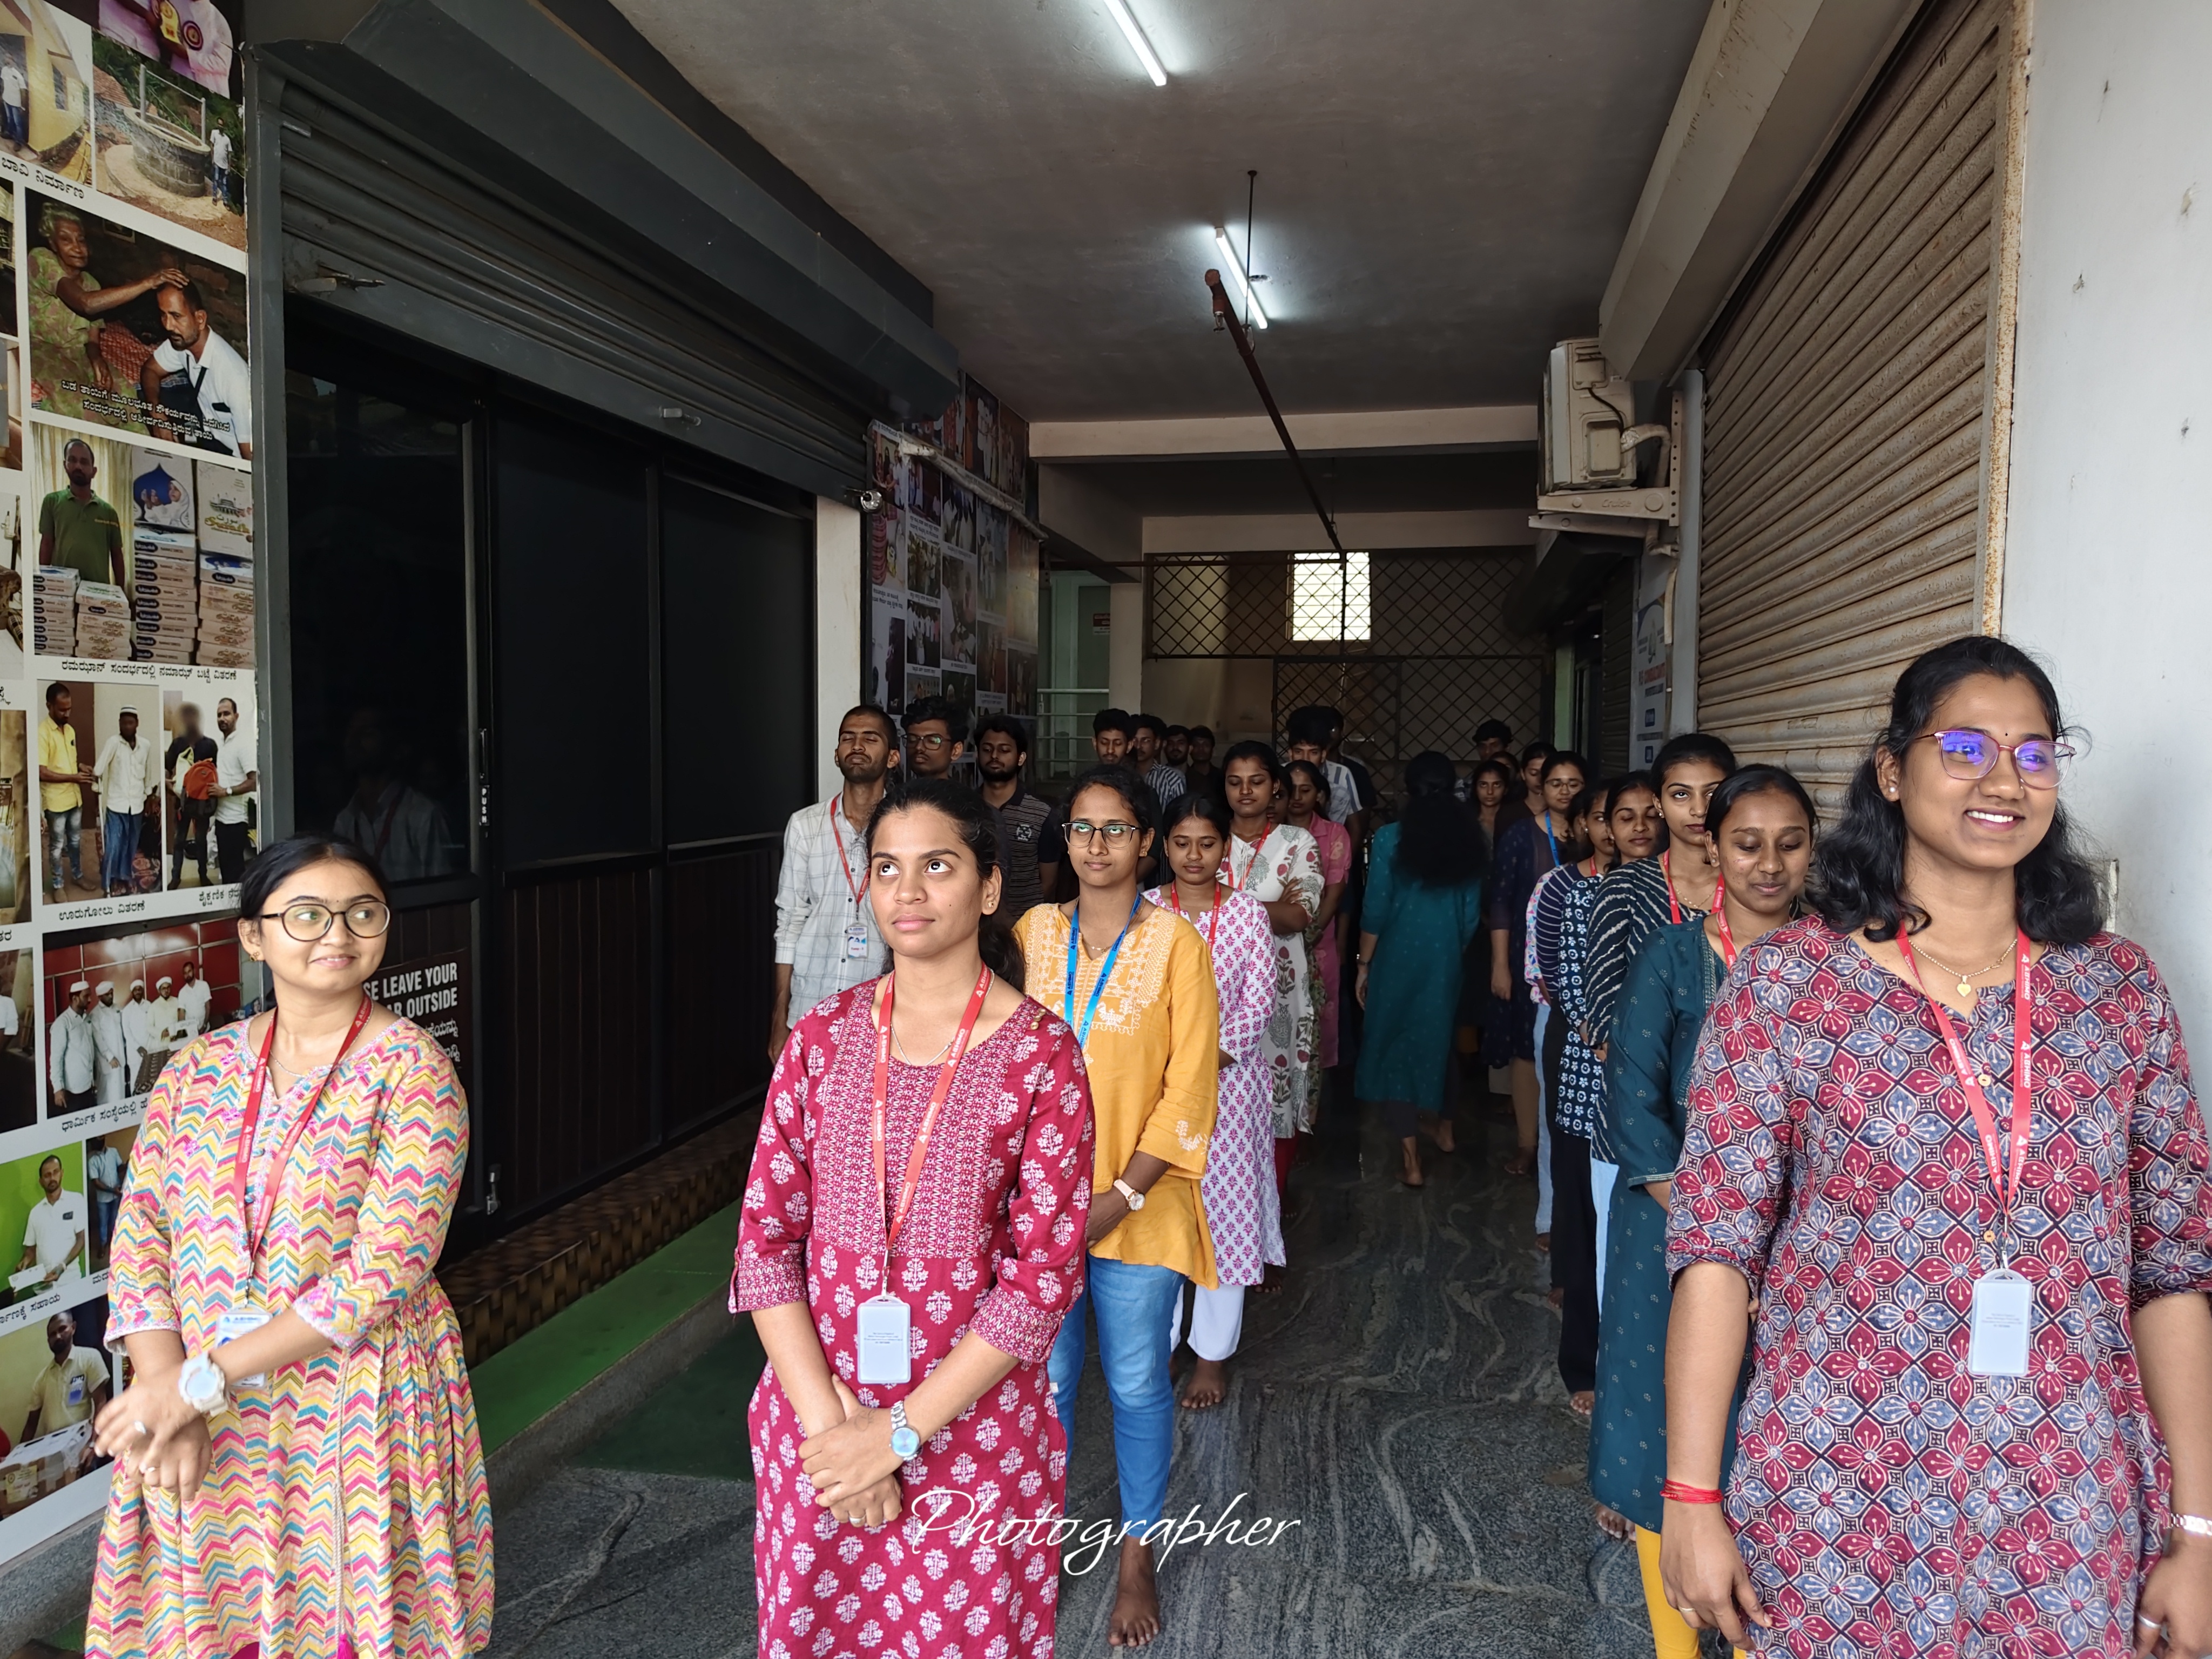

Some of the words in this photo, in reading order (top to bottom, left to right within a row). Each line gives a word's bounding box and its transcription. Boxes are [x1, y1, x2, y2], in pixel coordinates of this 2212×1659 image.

[36, 170, 84, 199] ನಿರ್ಮಾಣ
[111, 663, 156, 680] ಸಂದರ್ಭದಲ್ಲಿ
[214, 670, 237, 680] ವಿತರಣೆ
[59, 906, 113, 920] ಊರುಗೋಲು
[118, 900, 145, 914] ವಿತರಣೆ
[383, 970, 422, 999] LEAVE
[425, 962, 458, 988] YOUR
[406, 987, 458, 1019] OUTSIDE
[62, 1112, 96, 1132] ಧಾರ್ಮಿಕ
[100, 1101, 137, 1122] ಸಂಸ್ಥೆಯಲ್ಲಿ
[1985, 1135, 1998, 1173] ABHIMO
[2014, 1148, 2026, 1188] ABHIMO
[30, 1293, 60, 1312] ಸಹಾಯ
